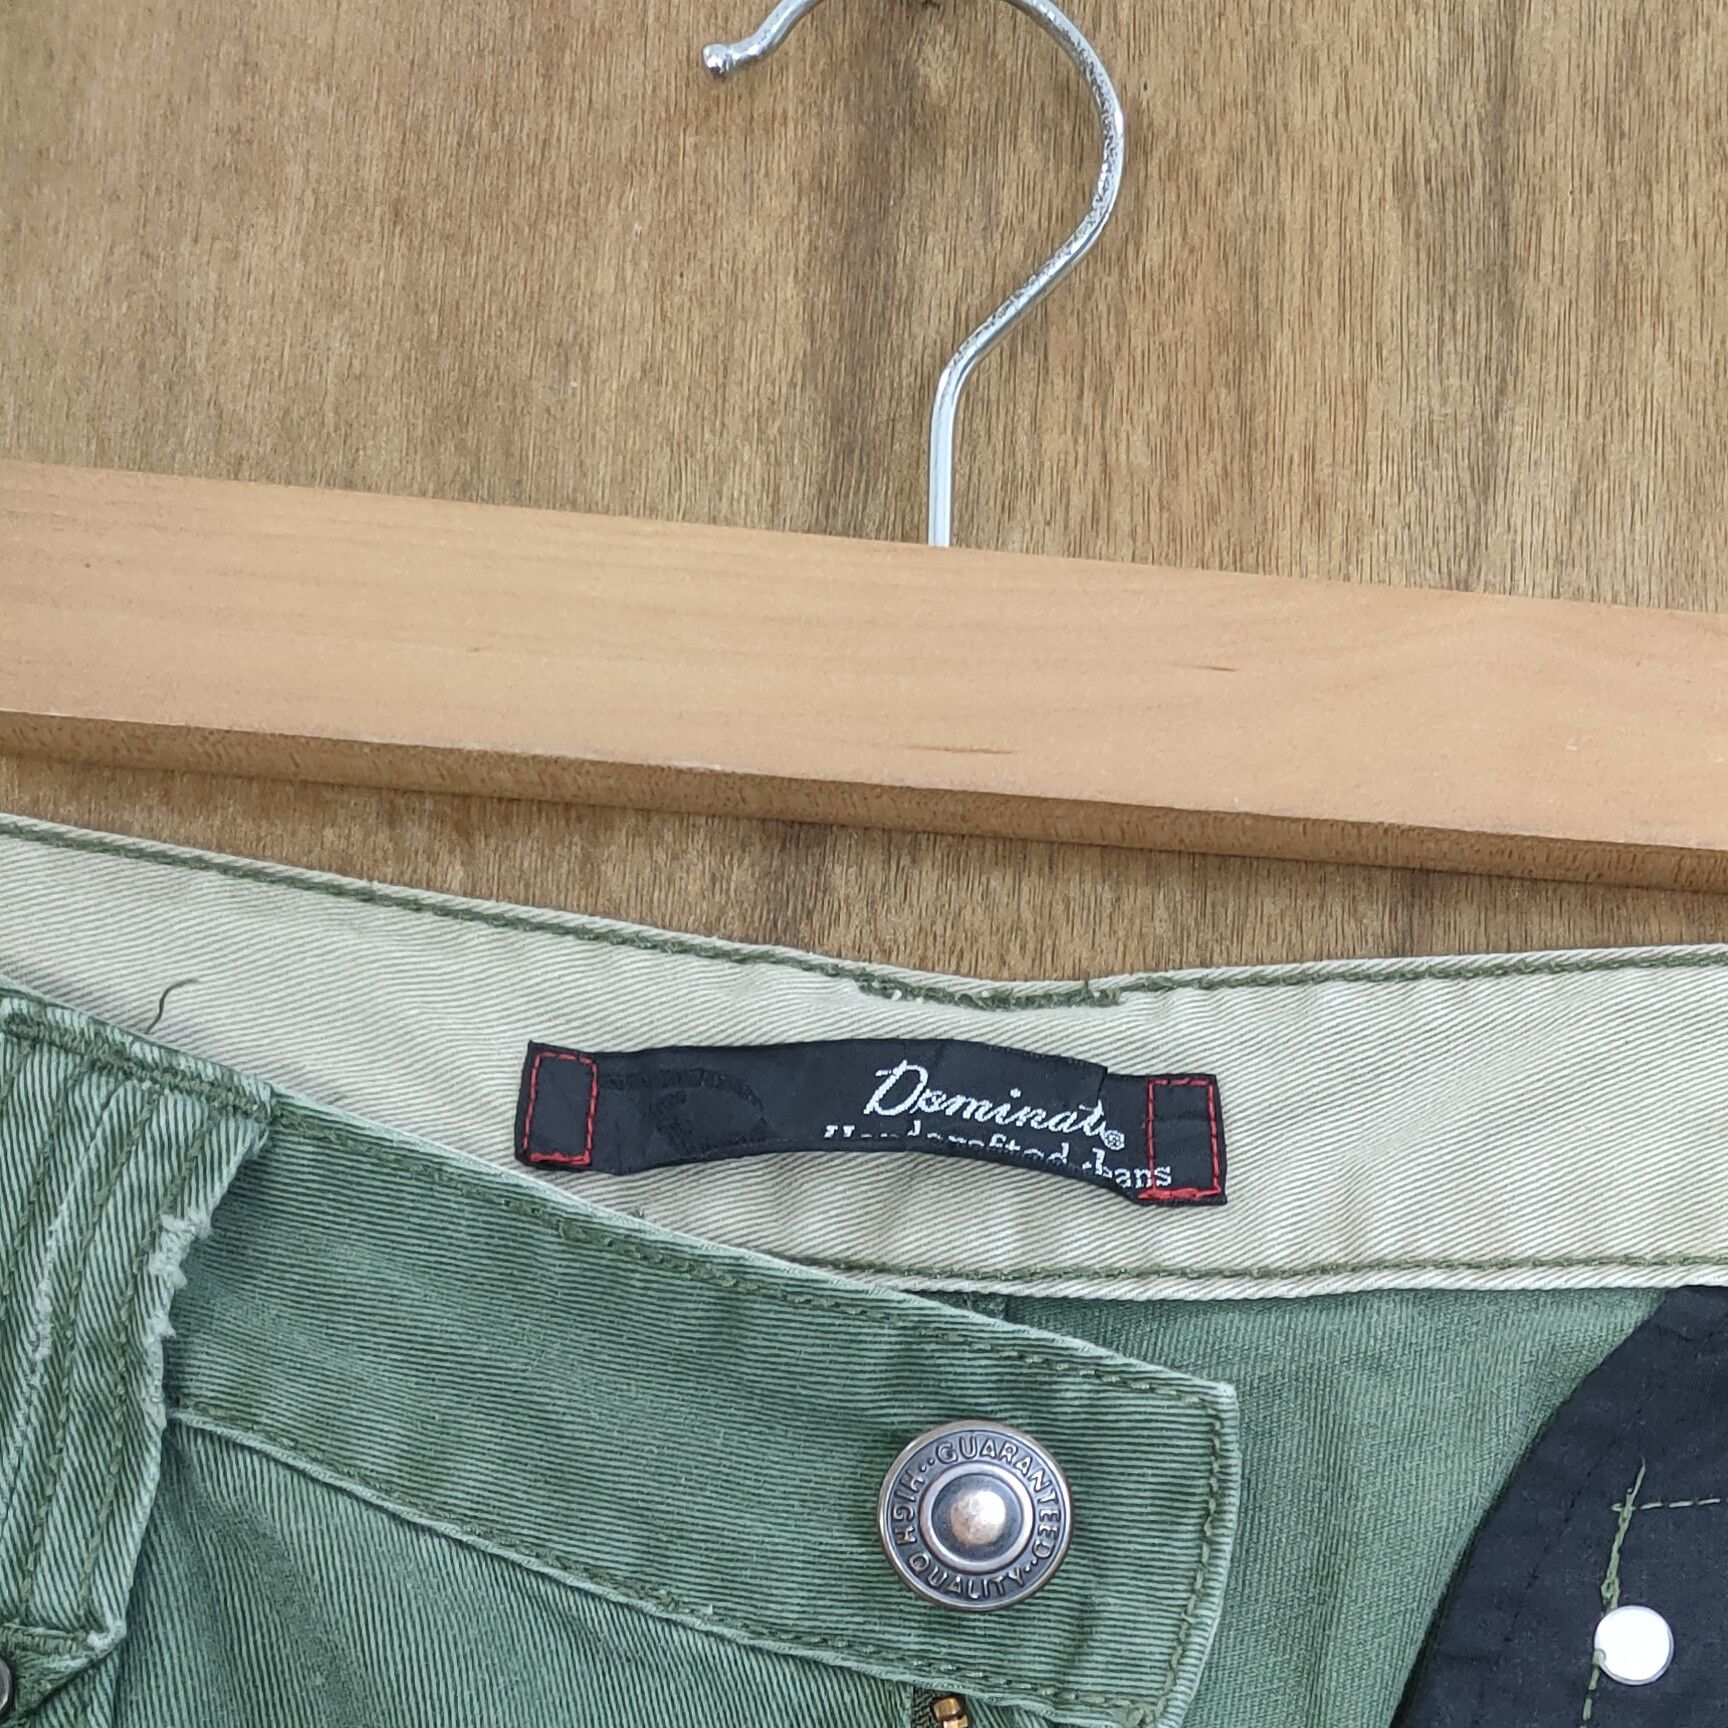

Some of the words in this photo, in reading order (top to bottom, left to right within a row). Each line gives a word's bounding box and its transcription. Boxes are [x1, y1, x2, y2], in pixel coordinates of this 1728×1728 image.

[892, 1469, 926, 1545] HIGH
[935, 1436, 1061, 1559] GUARANTEED
[908, 1552, 1026, 1599] QUALITY
